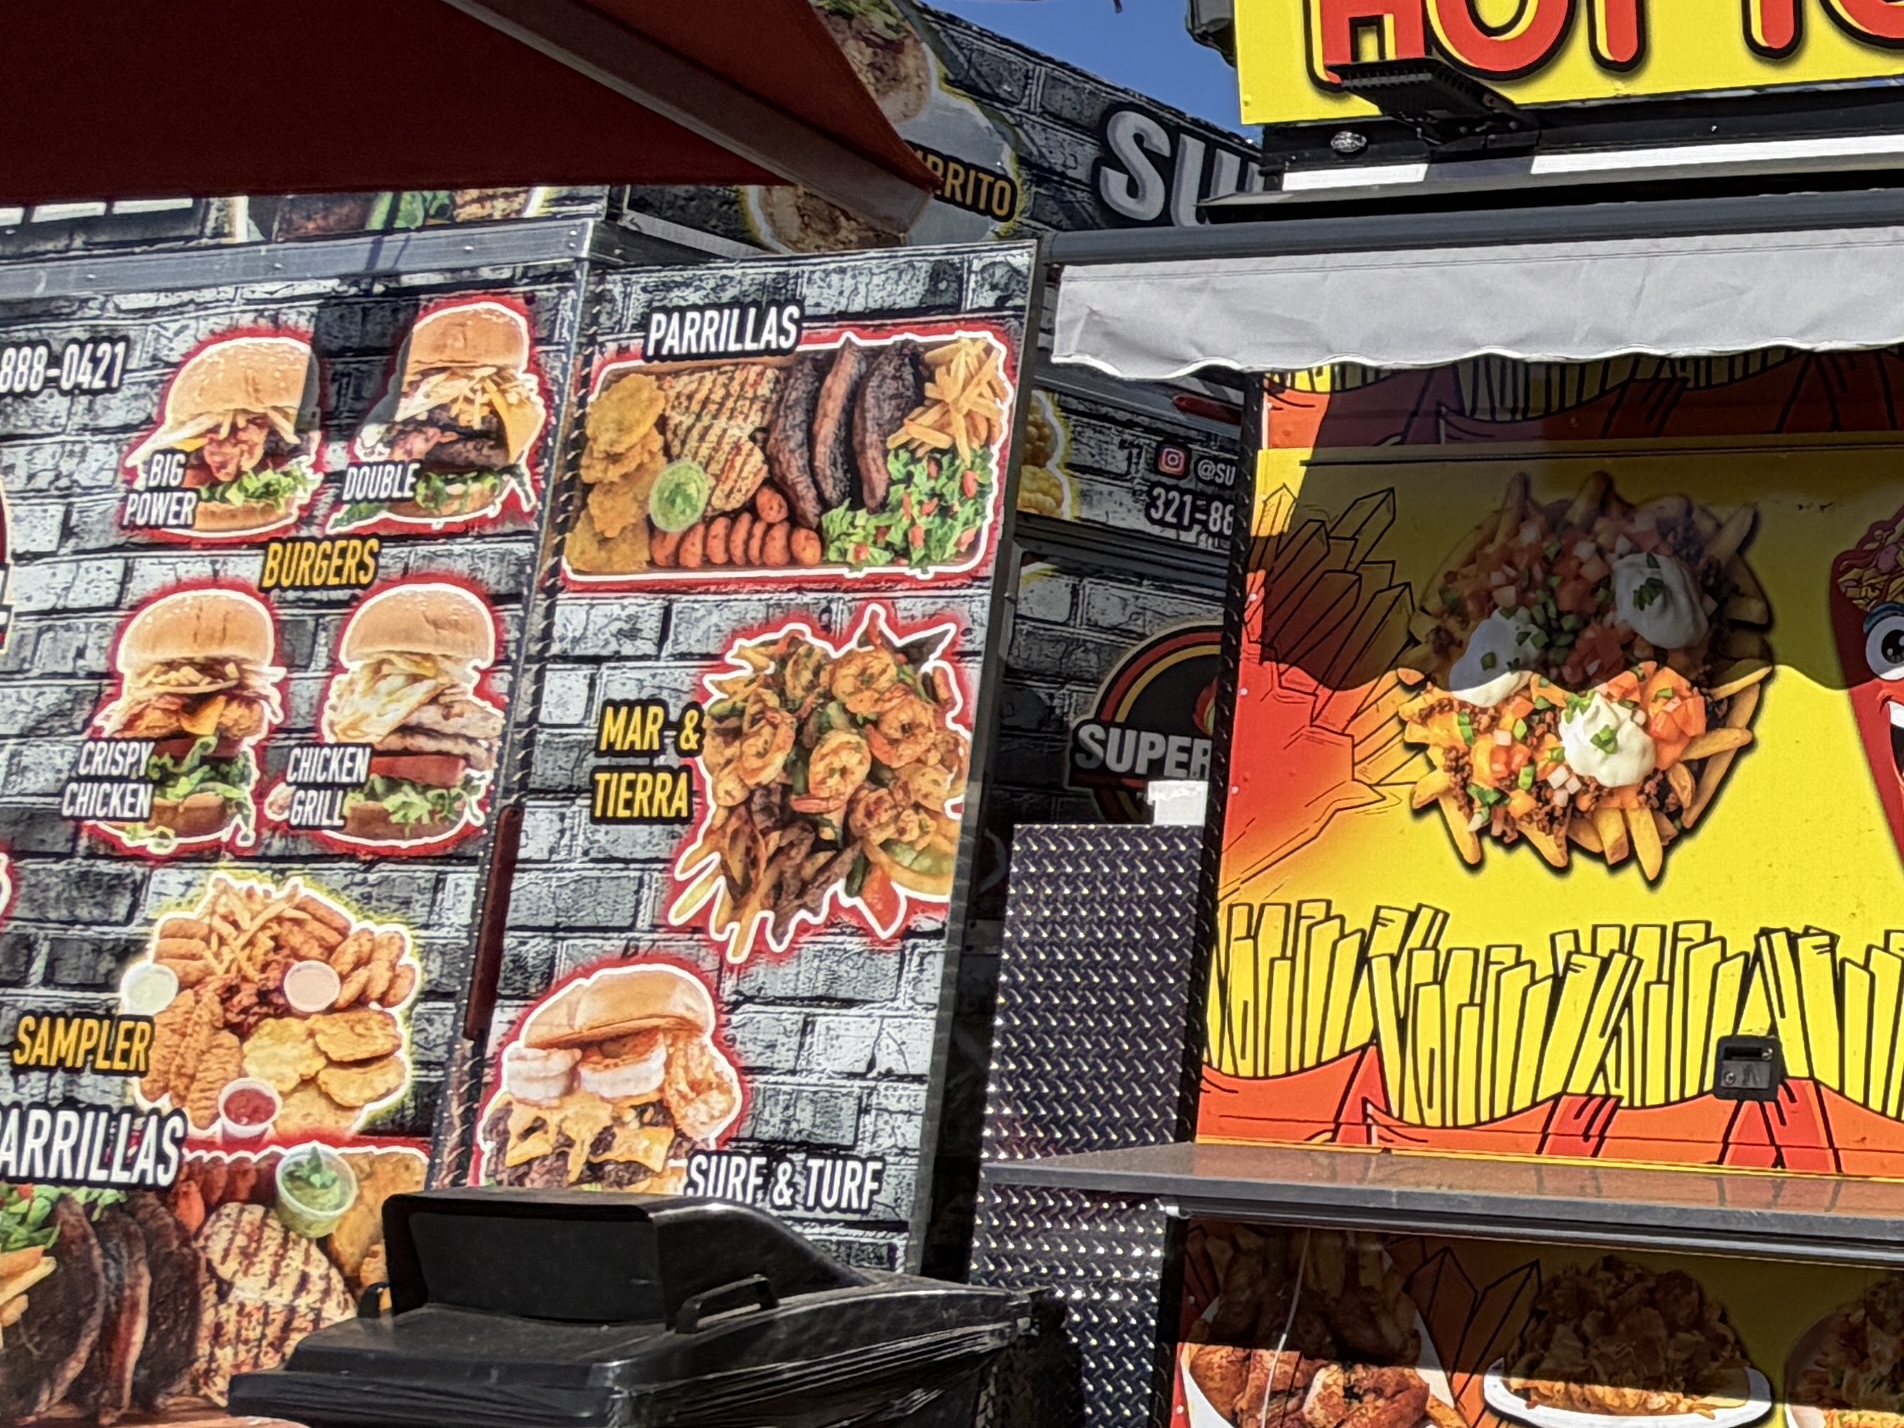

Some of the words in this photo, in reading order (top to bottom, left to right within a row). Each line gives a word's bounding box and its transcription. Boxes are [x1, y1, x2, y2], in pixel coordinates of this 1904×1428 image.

[648, 305, 800, 356] PARRILLAS
[148, 453, 185, 487] BIG
[343, 463, 420, 501] DOUBLE
[123, 490, 197, 526] POWER
[261, 539, 379, 590] BURGERS
[599, 706, 663, 751] MAR
[679, 706, 701, 749] &
[78, 740, 156, 776] CRISPY
[287, 747, 373, 784] CHICKEN
[62, 783, 155, 819] CHICKEN
[289, 789, 347, 828] GRILL
[593, 771, 689, 818] TIERRA
[13, 1015, 153, 1074] SAMPLER
[0, 1108, 186, 1187] ARRILLAS
[687, 1155, 767, 1203] SURF
[772, 1162, 795, 1206] &
[805, 1158, 883, 1210] TURF
